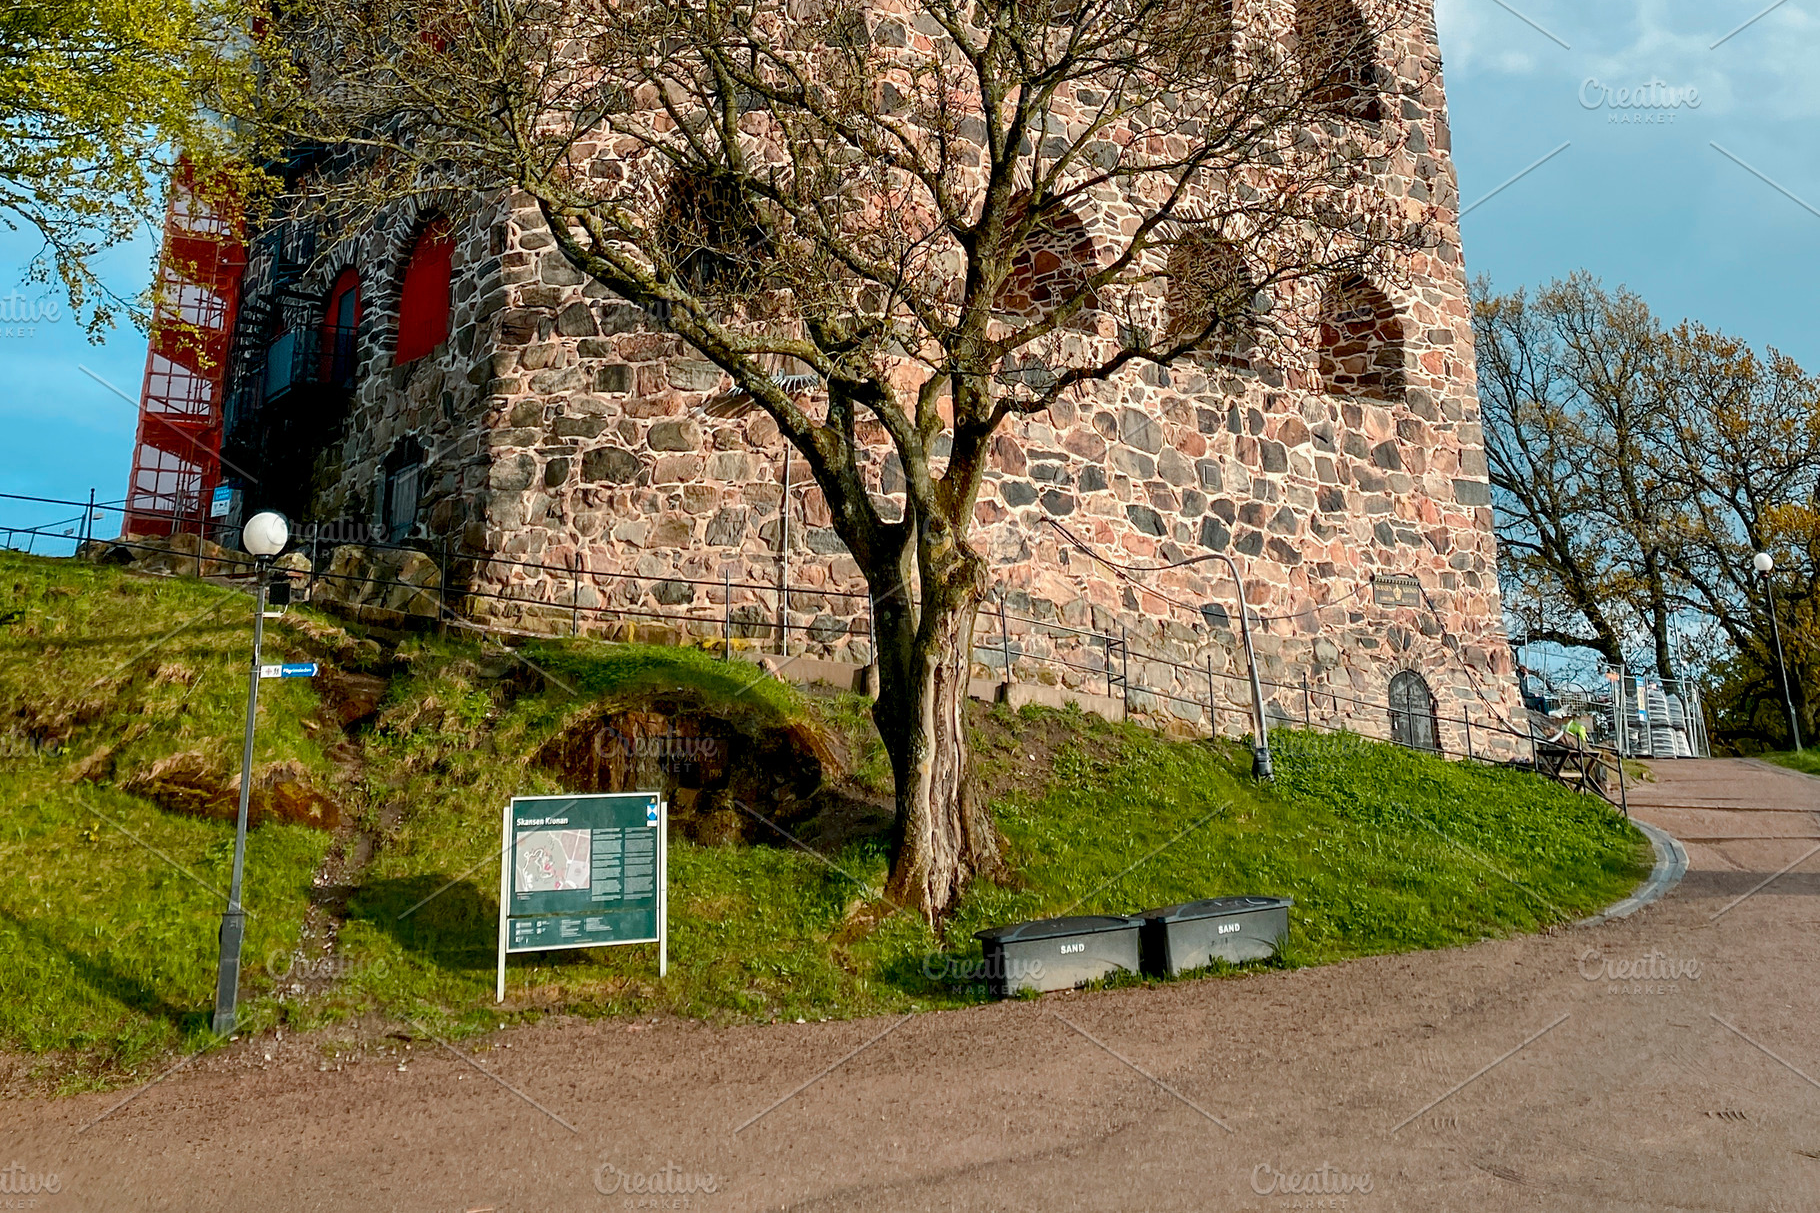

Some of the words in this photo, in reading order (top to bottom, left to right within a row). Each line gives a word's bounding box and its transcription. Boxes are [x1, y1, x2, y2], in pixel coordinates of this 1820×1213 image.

[516, 817, 544, 826] Skansen
[545, 816, 569, 825] Kronan
[1217, 922, 1241, 935] SAND
[1060, 943, 1085, 955] SAND
